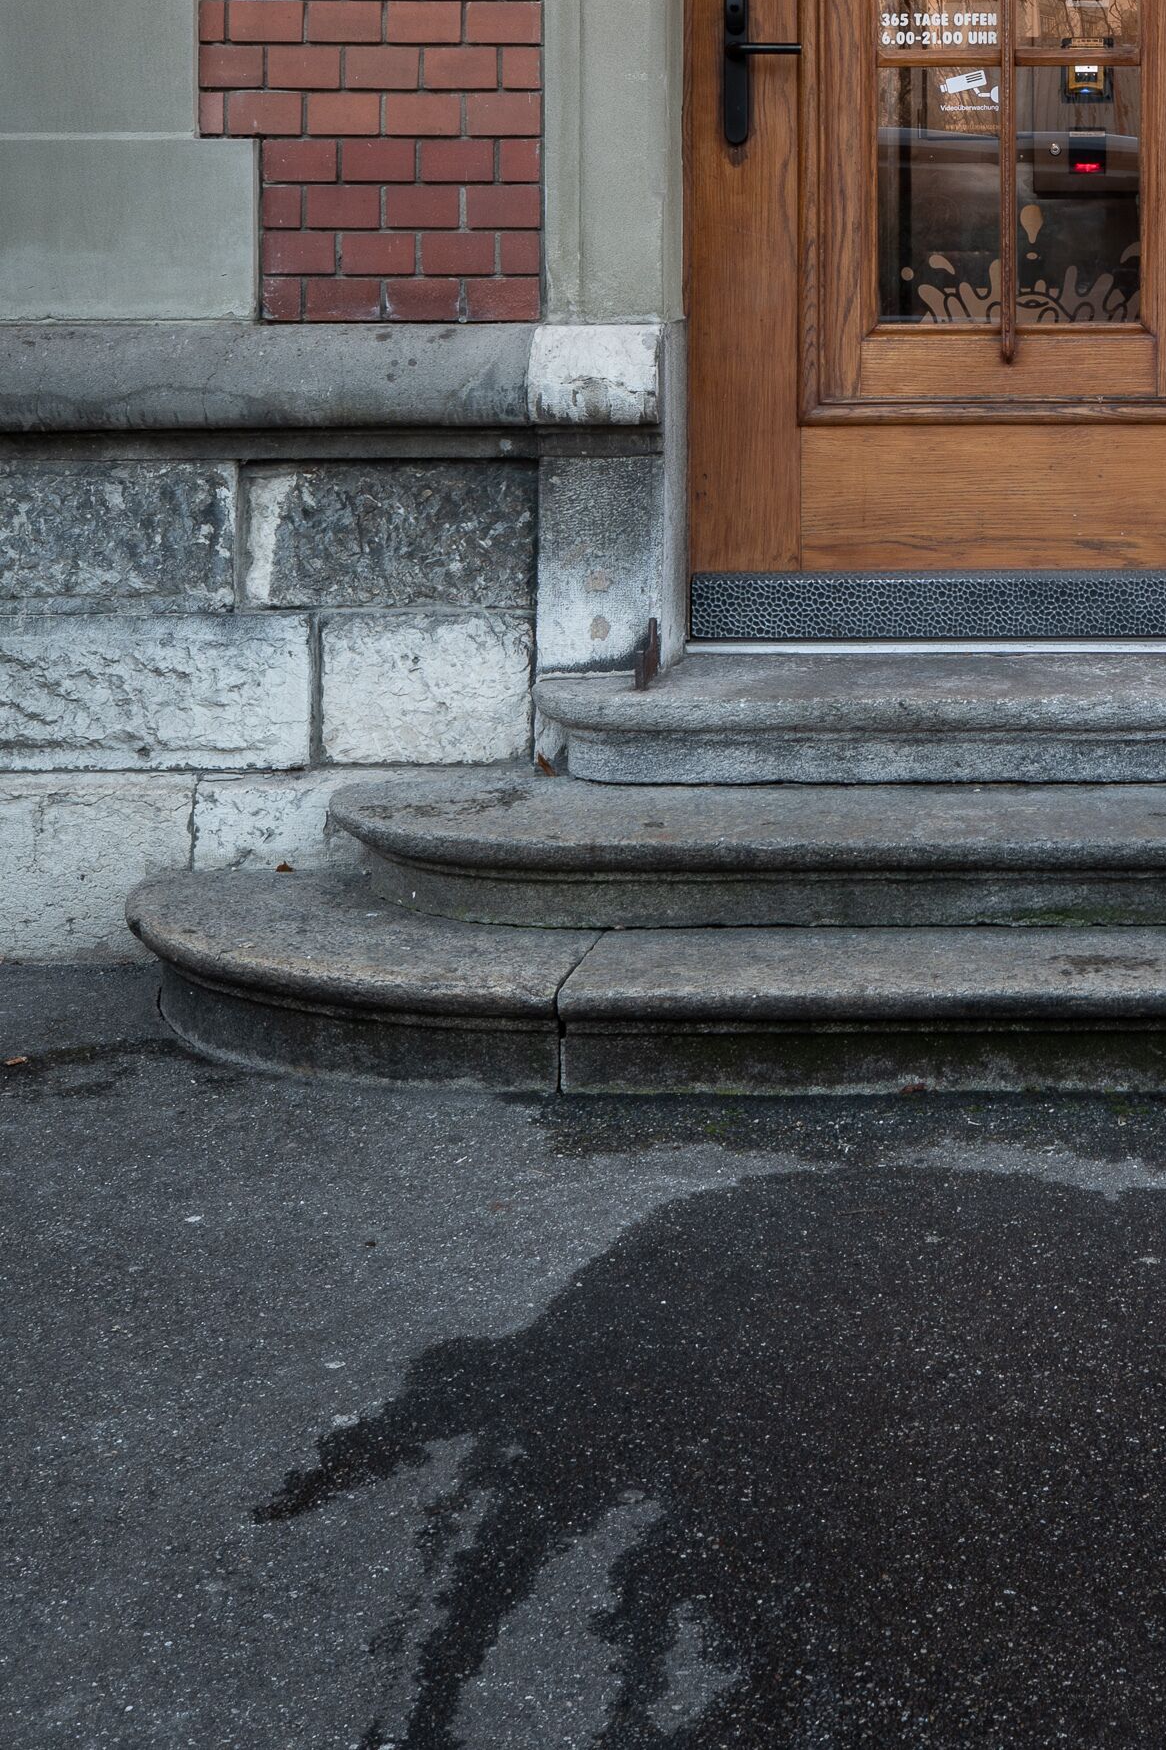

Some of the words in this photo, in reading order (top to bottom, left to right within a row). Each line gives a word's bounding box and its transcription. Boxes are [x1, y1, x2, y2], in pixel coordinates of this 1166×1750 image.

[881, 13, 909, 27] 365
[914, 13, 949, 26] TAGE
[953, 13, 998, 26] OFFEN
[881, 31, 963, 45] 6.00-21.00
[968, 31, 998, 45] UHR
[940, 104, 1000, 112] Videoüberwachung
